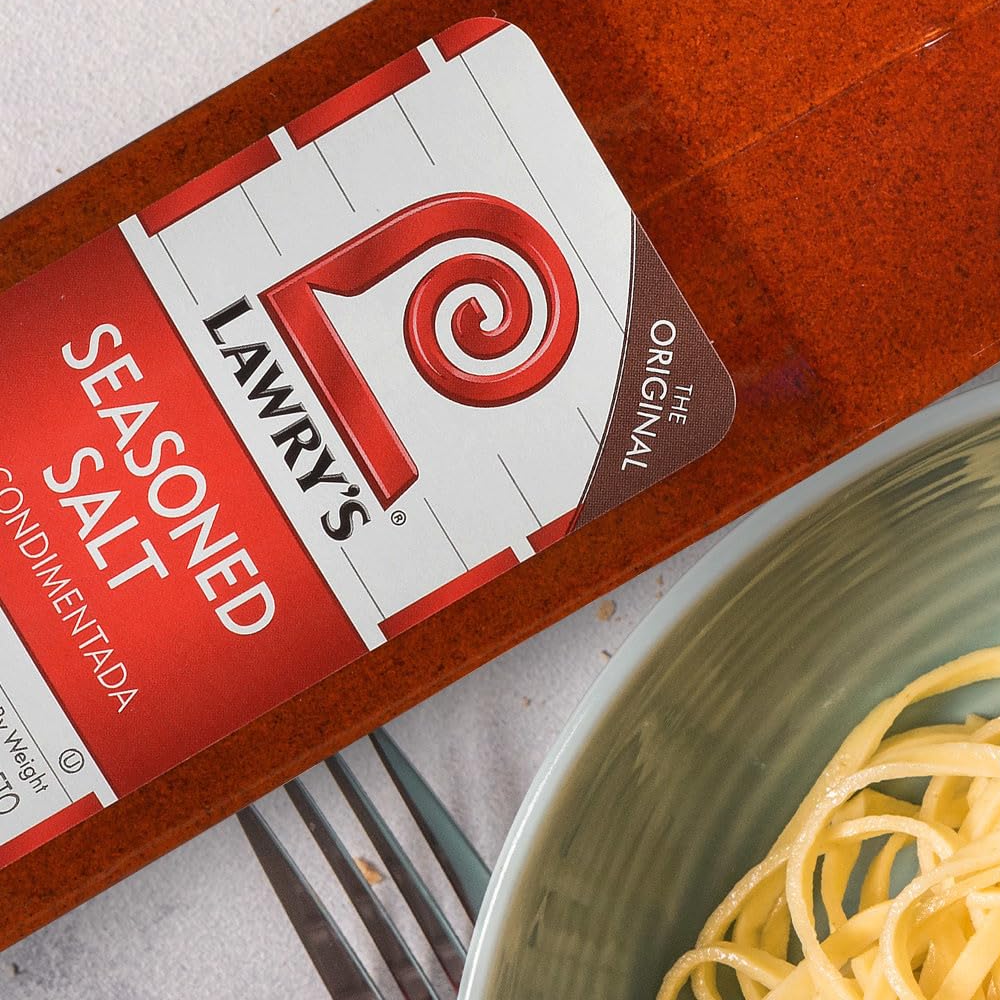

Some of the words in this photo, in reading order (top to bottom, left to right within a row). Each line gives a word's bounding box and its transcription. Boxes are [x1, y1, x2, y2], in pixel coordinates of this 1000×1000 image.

[202, 294, 371, 541] LAWRY'S
[621, 319, 676, 471] ORIGINAL
[669, 384, 693, 424] THE
[42, 446, 169, 589] SALT
[61, 323, 275, 635] SEASONED
[4, 729, 49, 793] Weight
